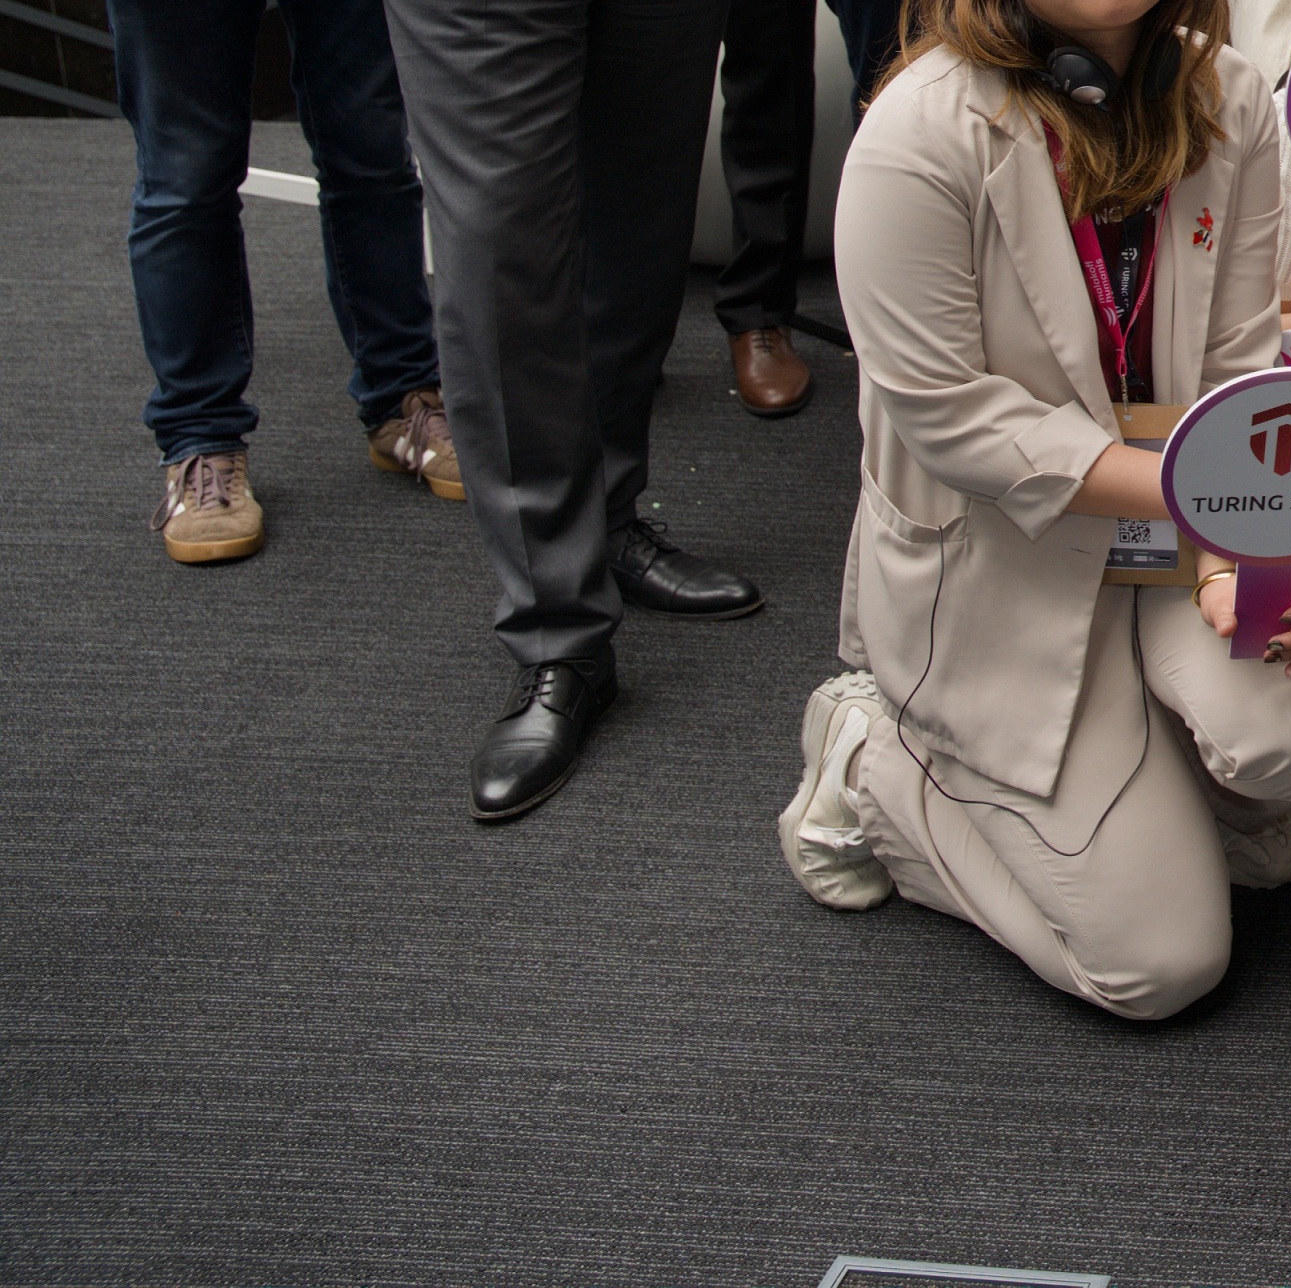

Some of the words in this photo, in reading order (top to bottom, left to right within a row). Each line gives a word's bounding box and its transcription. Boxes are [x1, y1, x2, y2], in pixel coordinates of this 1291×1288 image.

[1084, 260, 1105, 304] malakoff
[1095, 258, 1112, 304] humanis
[1192, 495, 1284, 513] TURING
